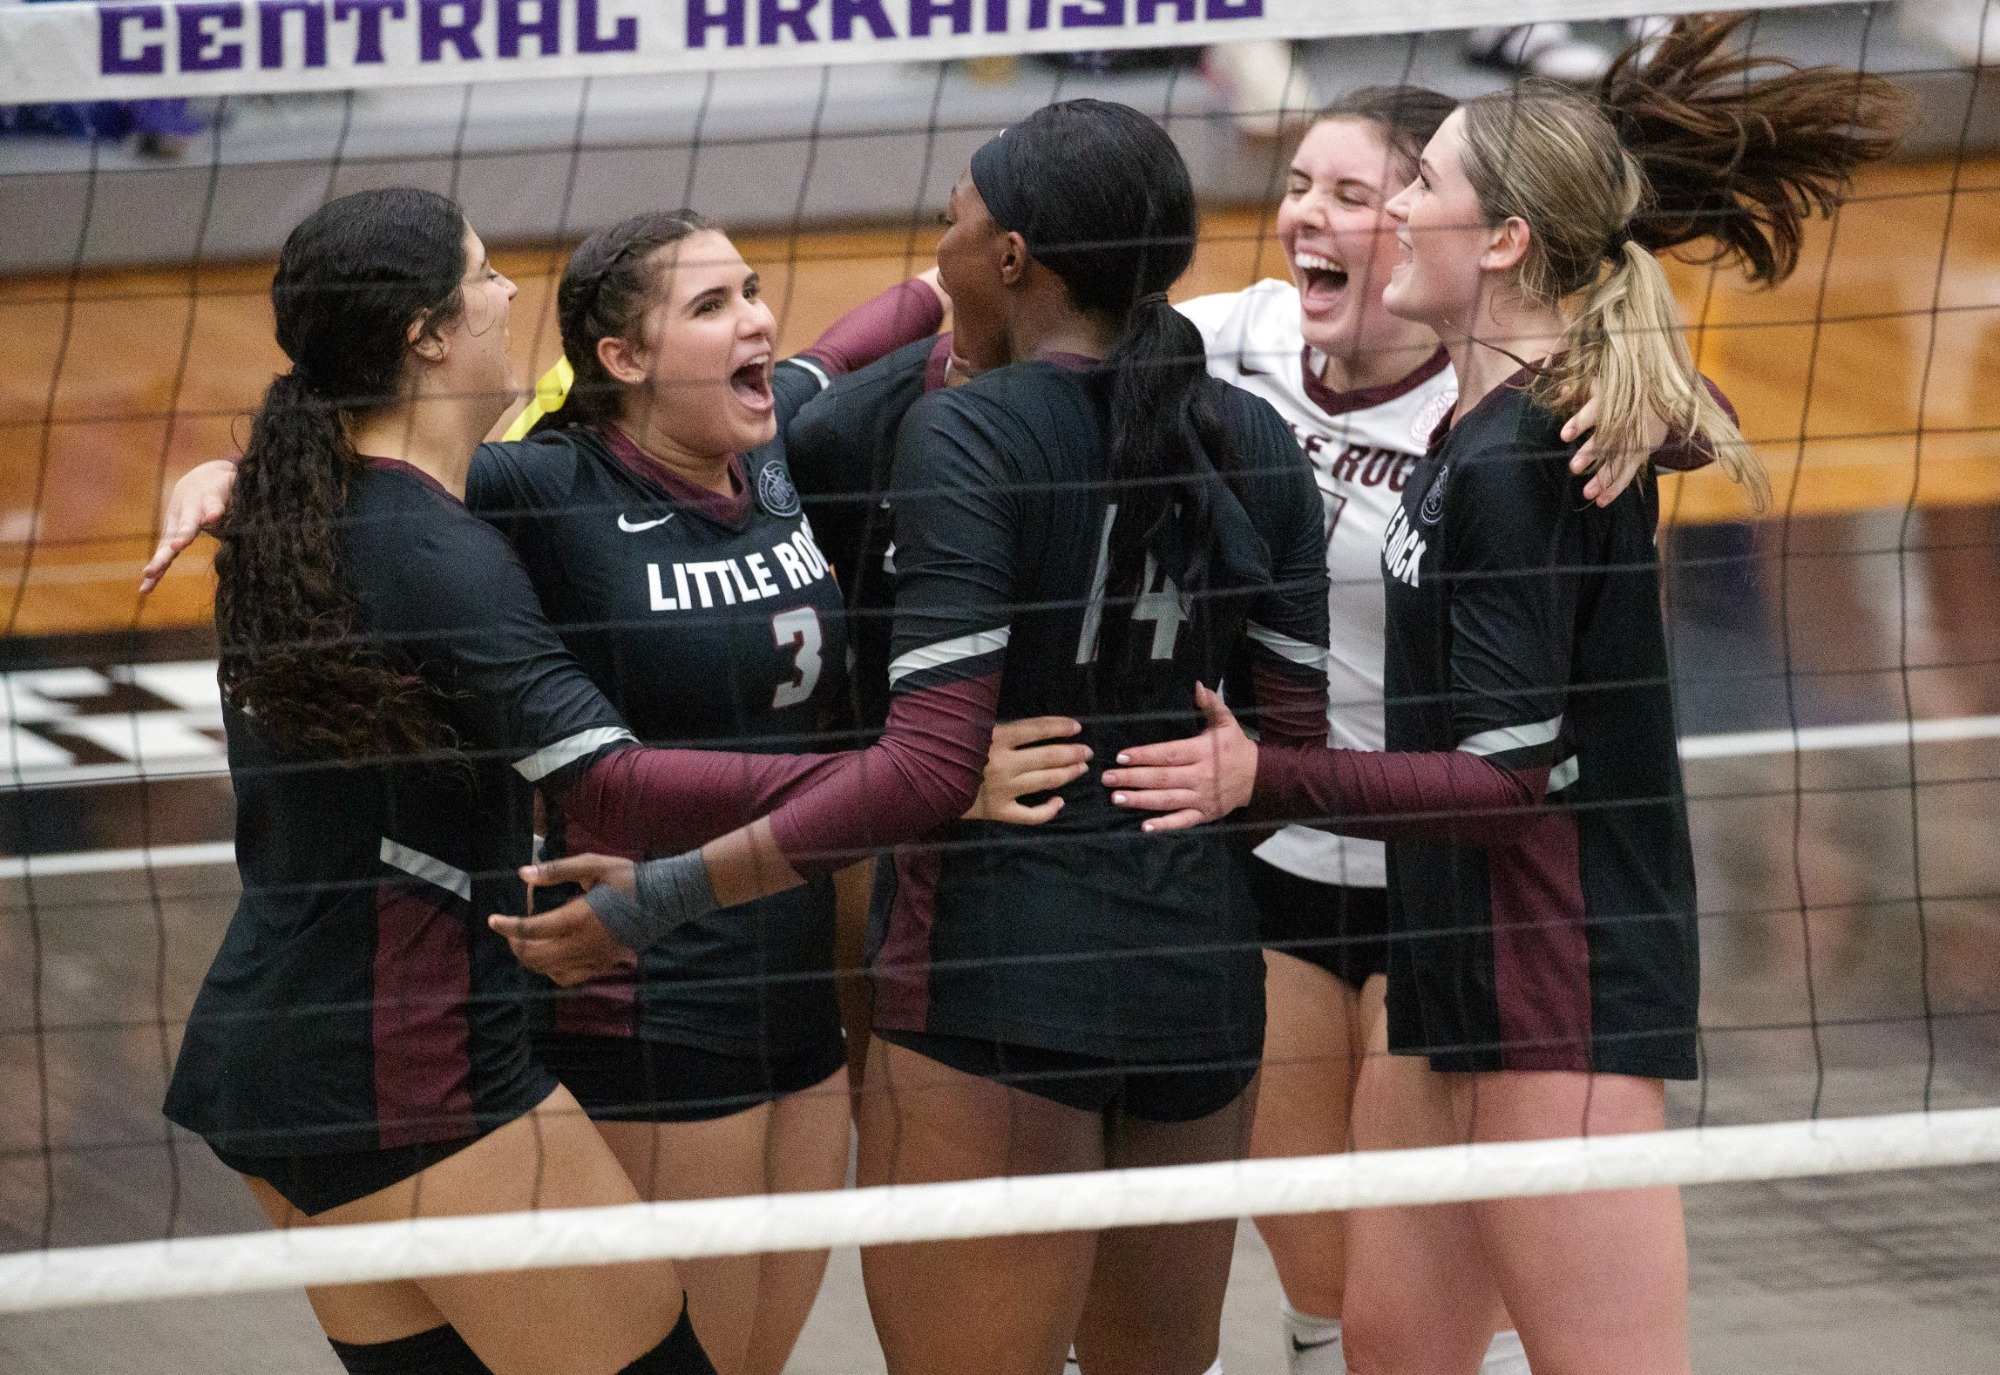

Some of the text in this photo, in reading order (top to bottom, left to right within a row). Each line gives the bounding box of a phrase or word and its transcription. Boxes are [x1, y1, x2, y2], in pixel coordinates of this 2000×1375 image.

[99, 0, 639, 75] CENTRAL
[646, 553, 781, 612] LITTLE
[1075, 502, 1195, 665] 14
[770, 604, 823, 709] 3
